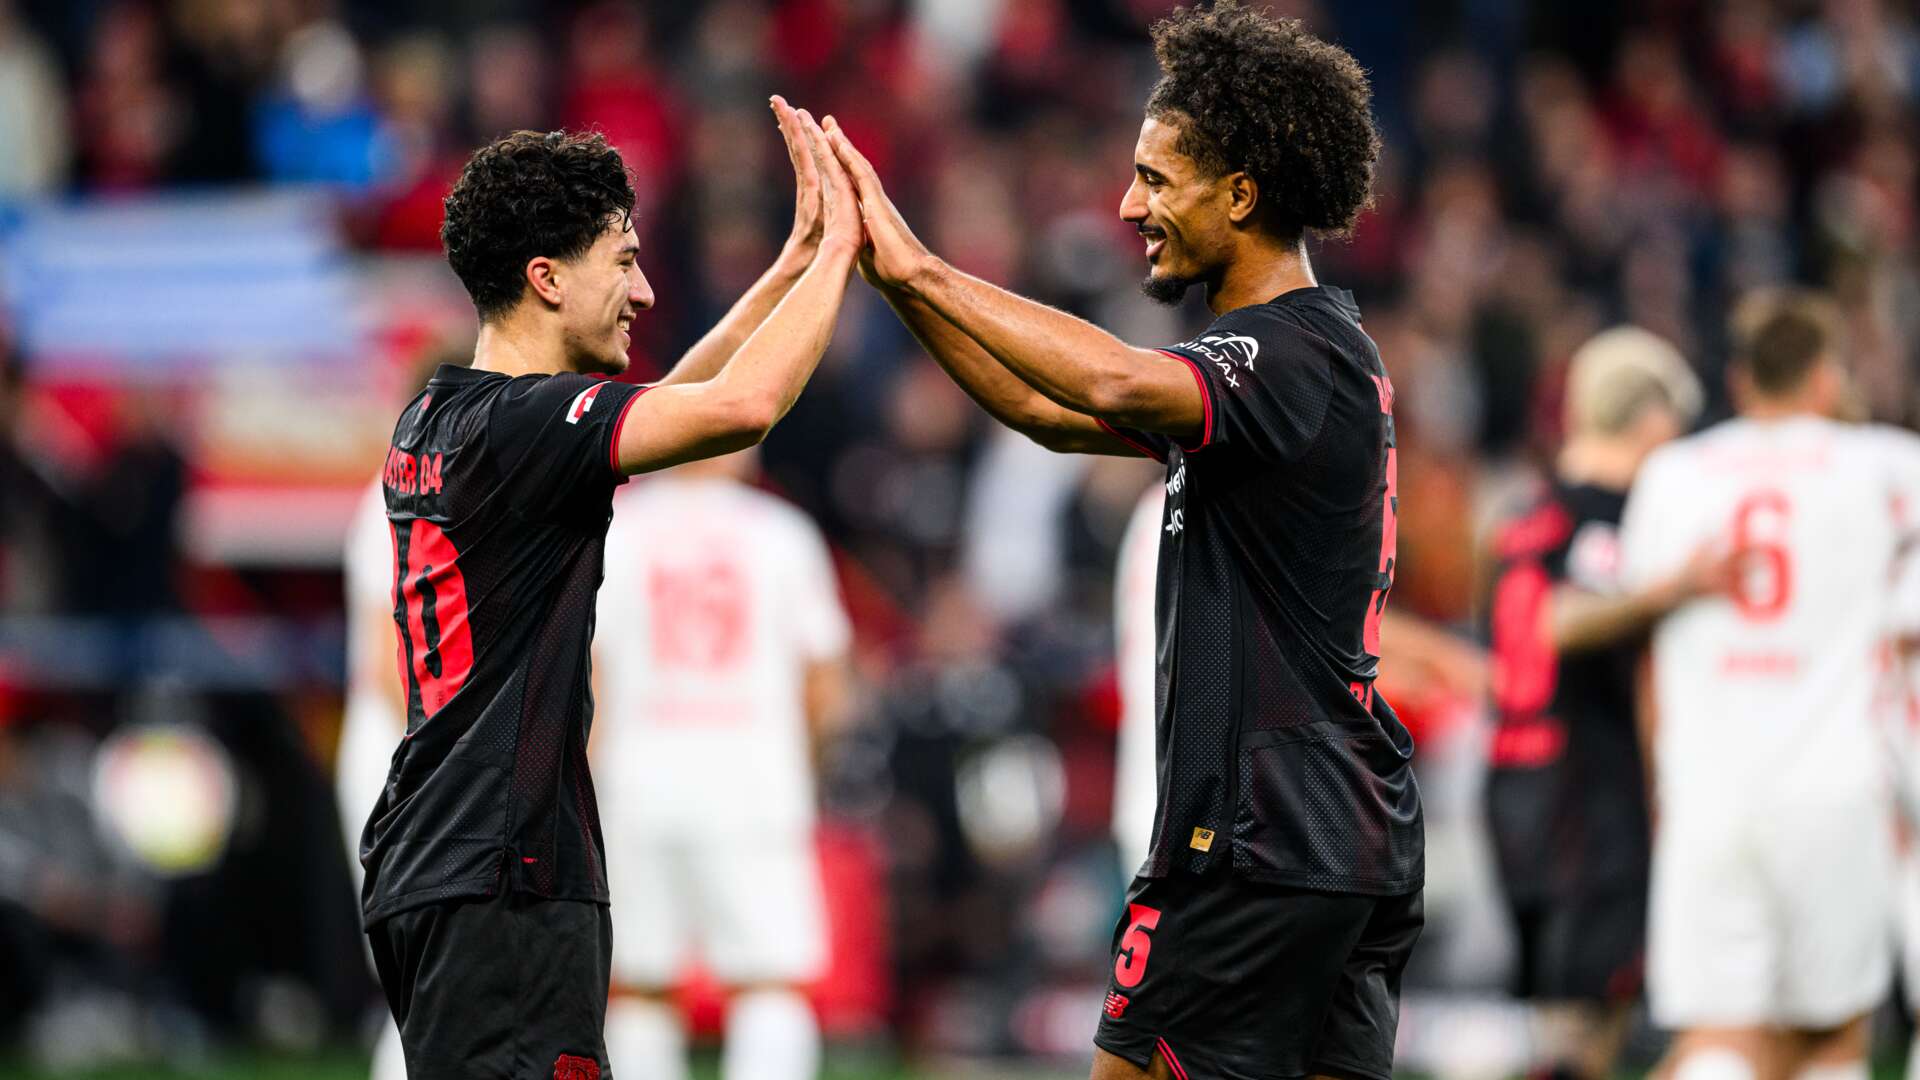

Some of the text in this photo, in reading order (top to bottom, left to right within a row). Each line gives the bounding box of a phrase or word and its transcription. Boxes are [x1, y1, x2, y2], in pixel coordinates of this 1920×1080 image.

[384, 446, 444, 496] AYER 04
[1732, 487, 1792, 624] 6
[1115, 903, 1162, 988] 5
